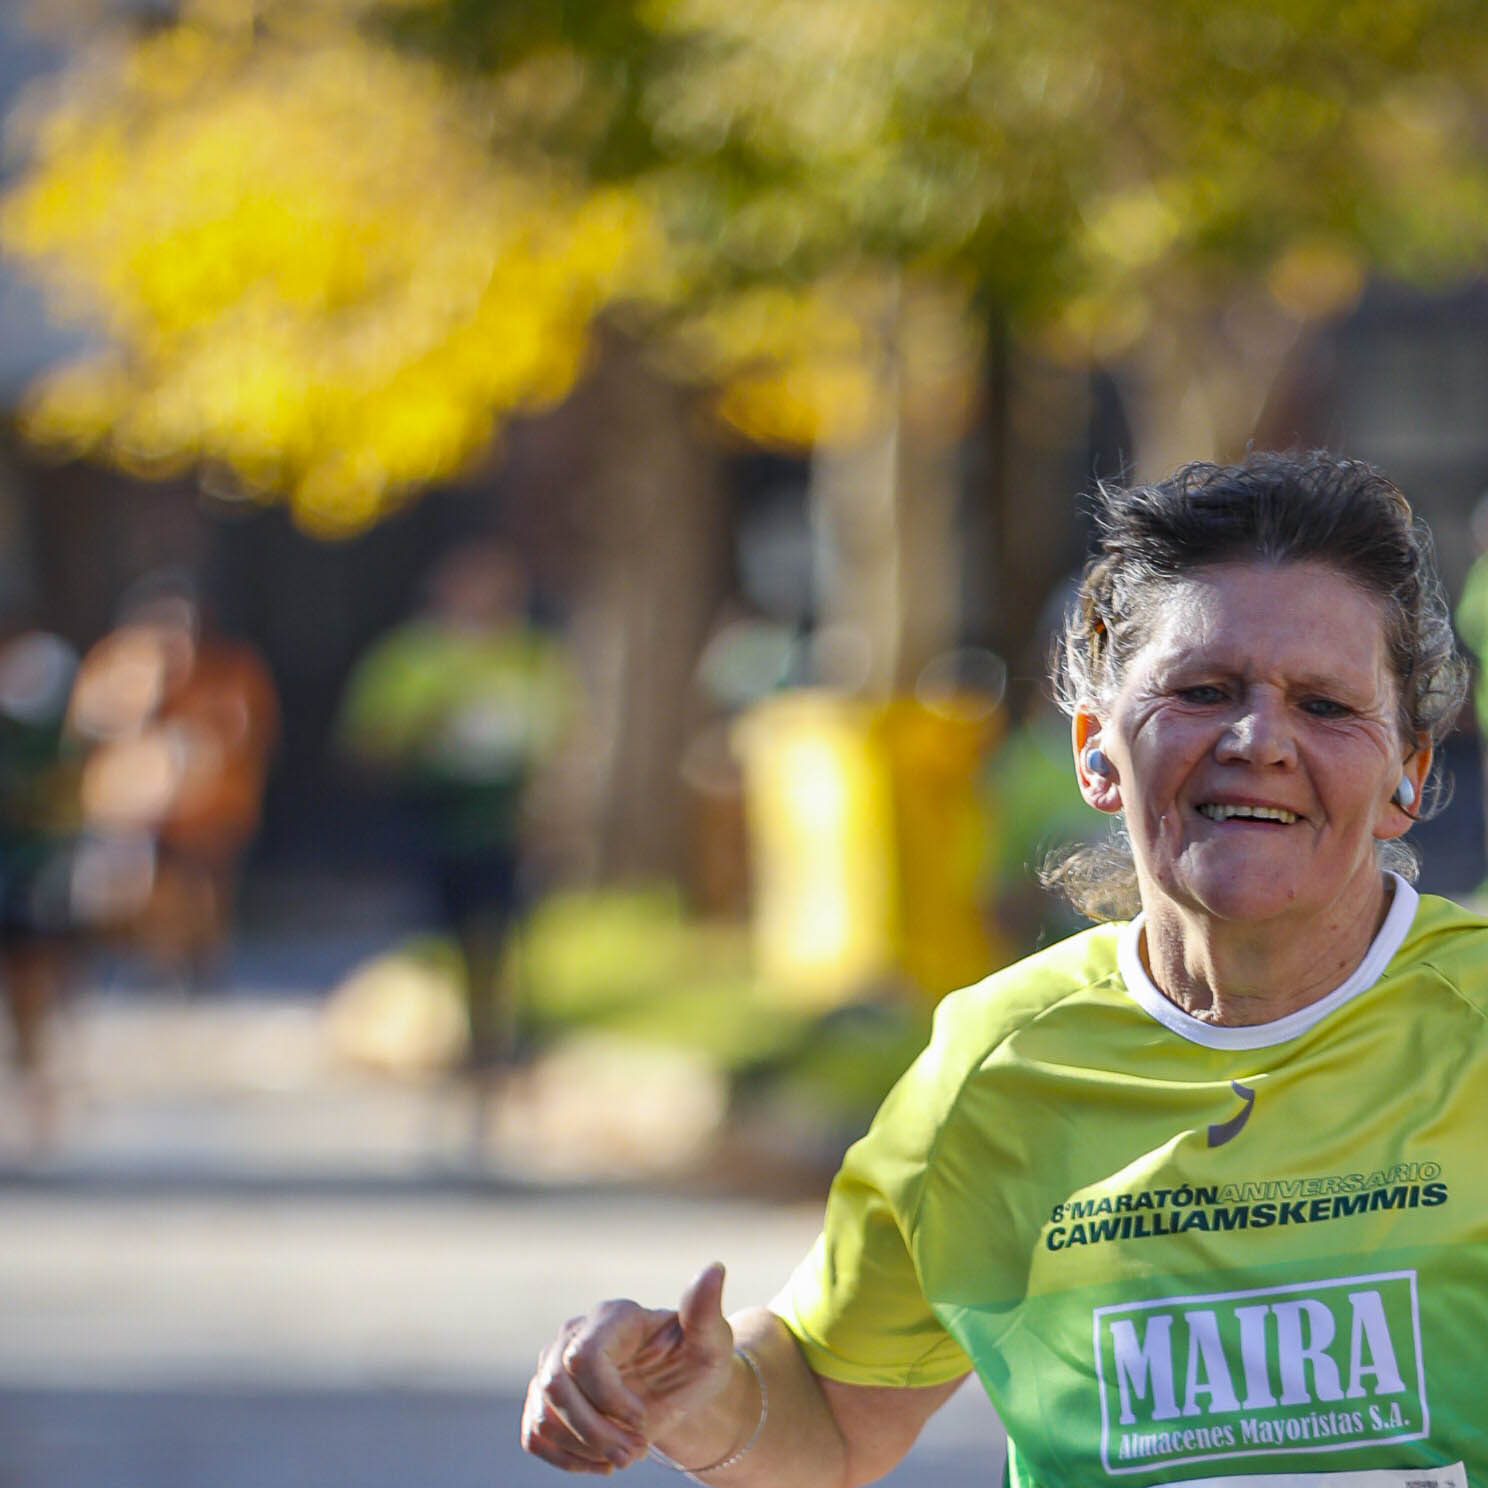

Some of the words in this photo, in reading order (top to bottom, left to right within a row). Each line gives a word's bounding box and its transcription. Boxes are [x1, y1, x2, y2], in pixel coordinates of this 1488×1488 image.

[1046, 1182, 1448, 1251] CAWILLIAMSKEMMIS
[1109, 1290, 1406, 1425] MAIRA
[1119, 1424, 1235, 1460] Almacenes
[1239, 1410, 1364, 1446] Mayoristas
[1368, 1402, 1410, 1431] S.A.
